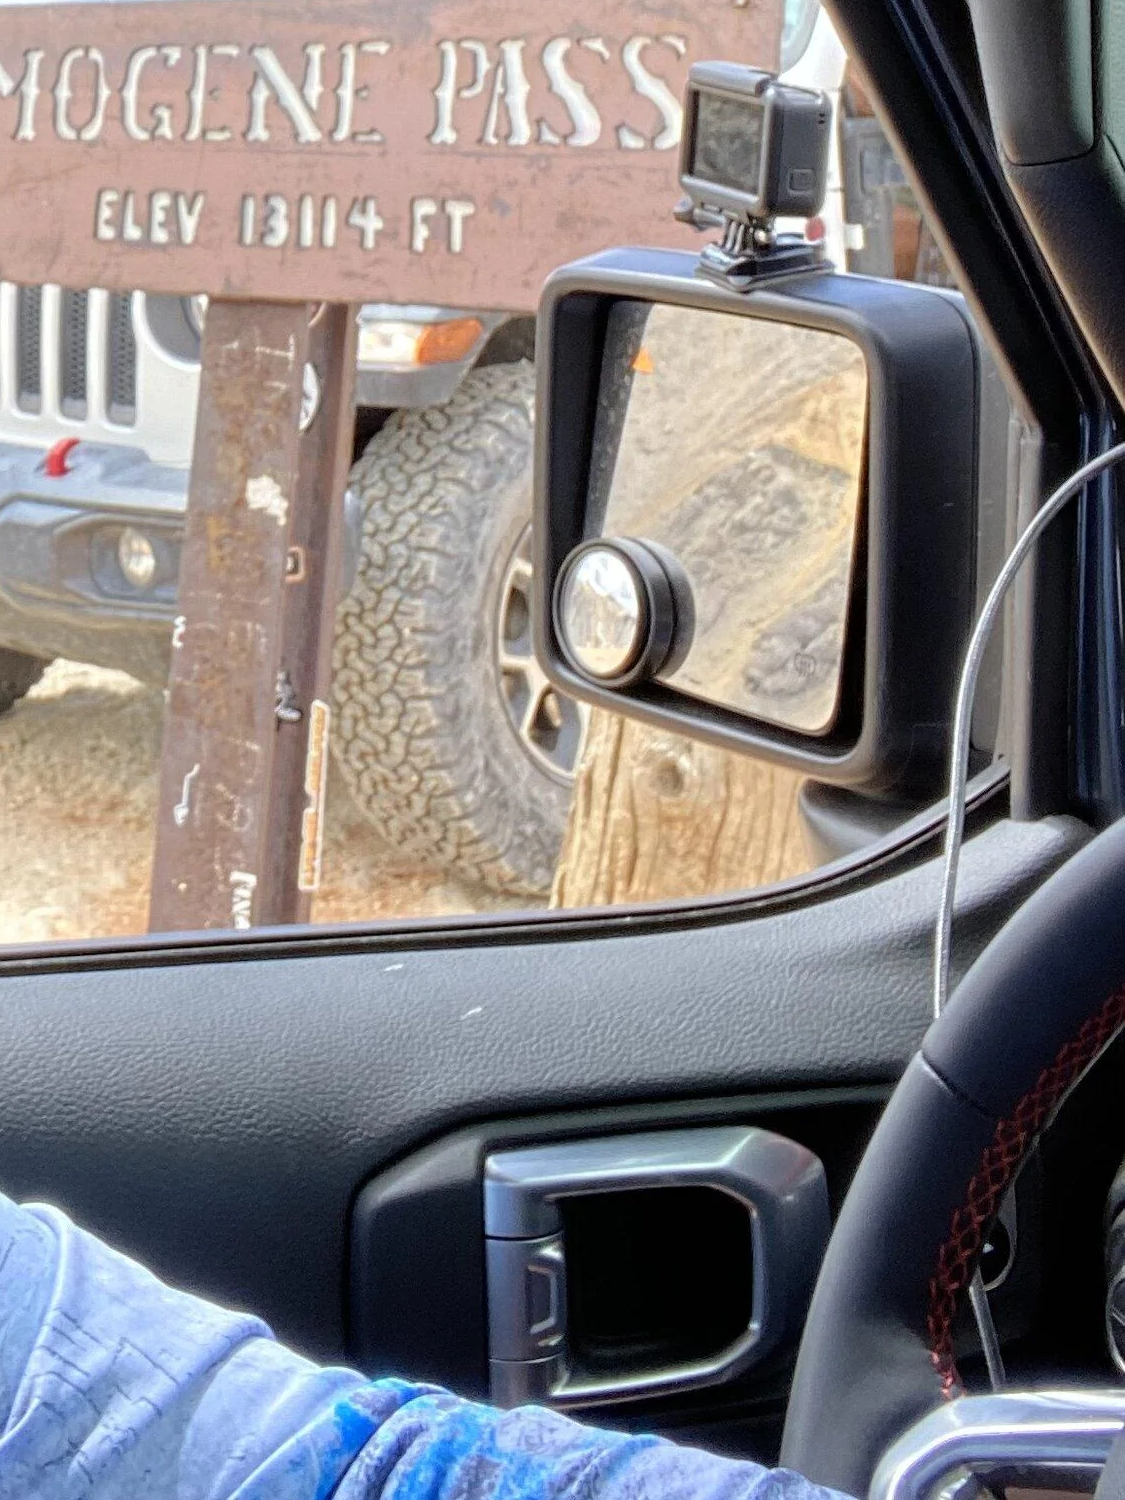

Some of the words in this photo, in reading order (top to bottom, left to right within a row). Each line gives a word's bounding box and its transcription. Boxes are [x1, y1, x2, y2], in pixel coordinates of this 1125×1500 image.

[428, 35, 687, 150] PASS
[96, 189, 206, 245] ELEV
[239, 193, 384, 251] 13114
[410, 197, 476, 254] FT
